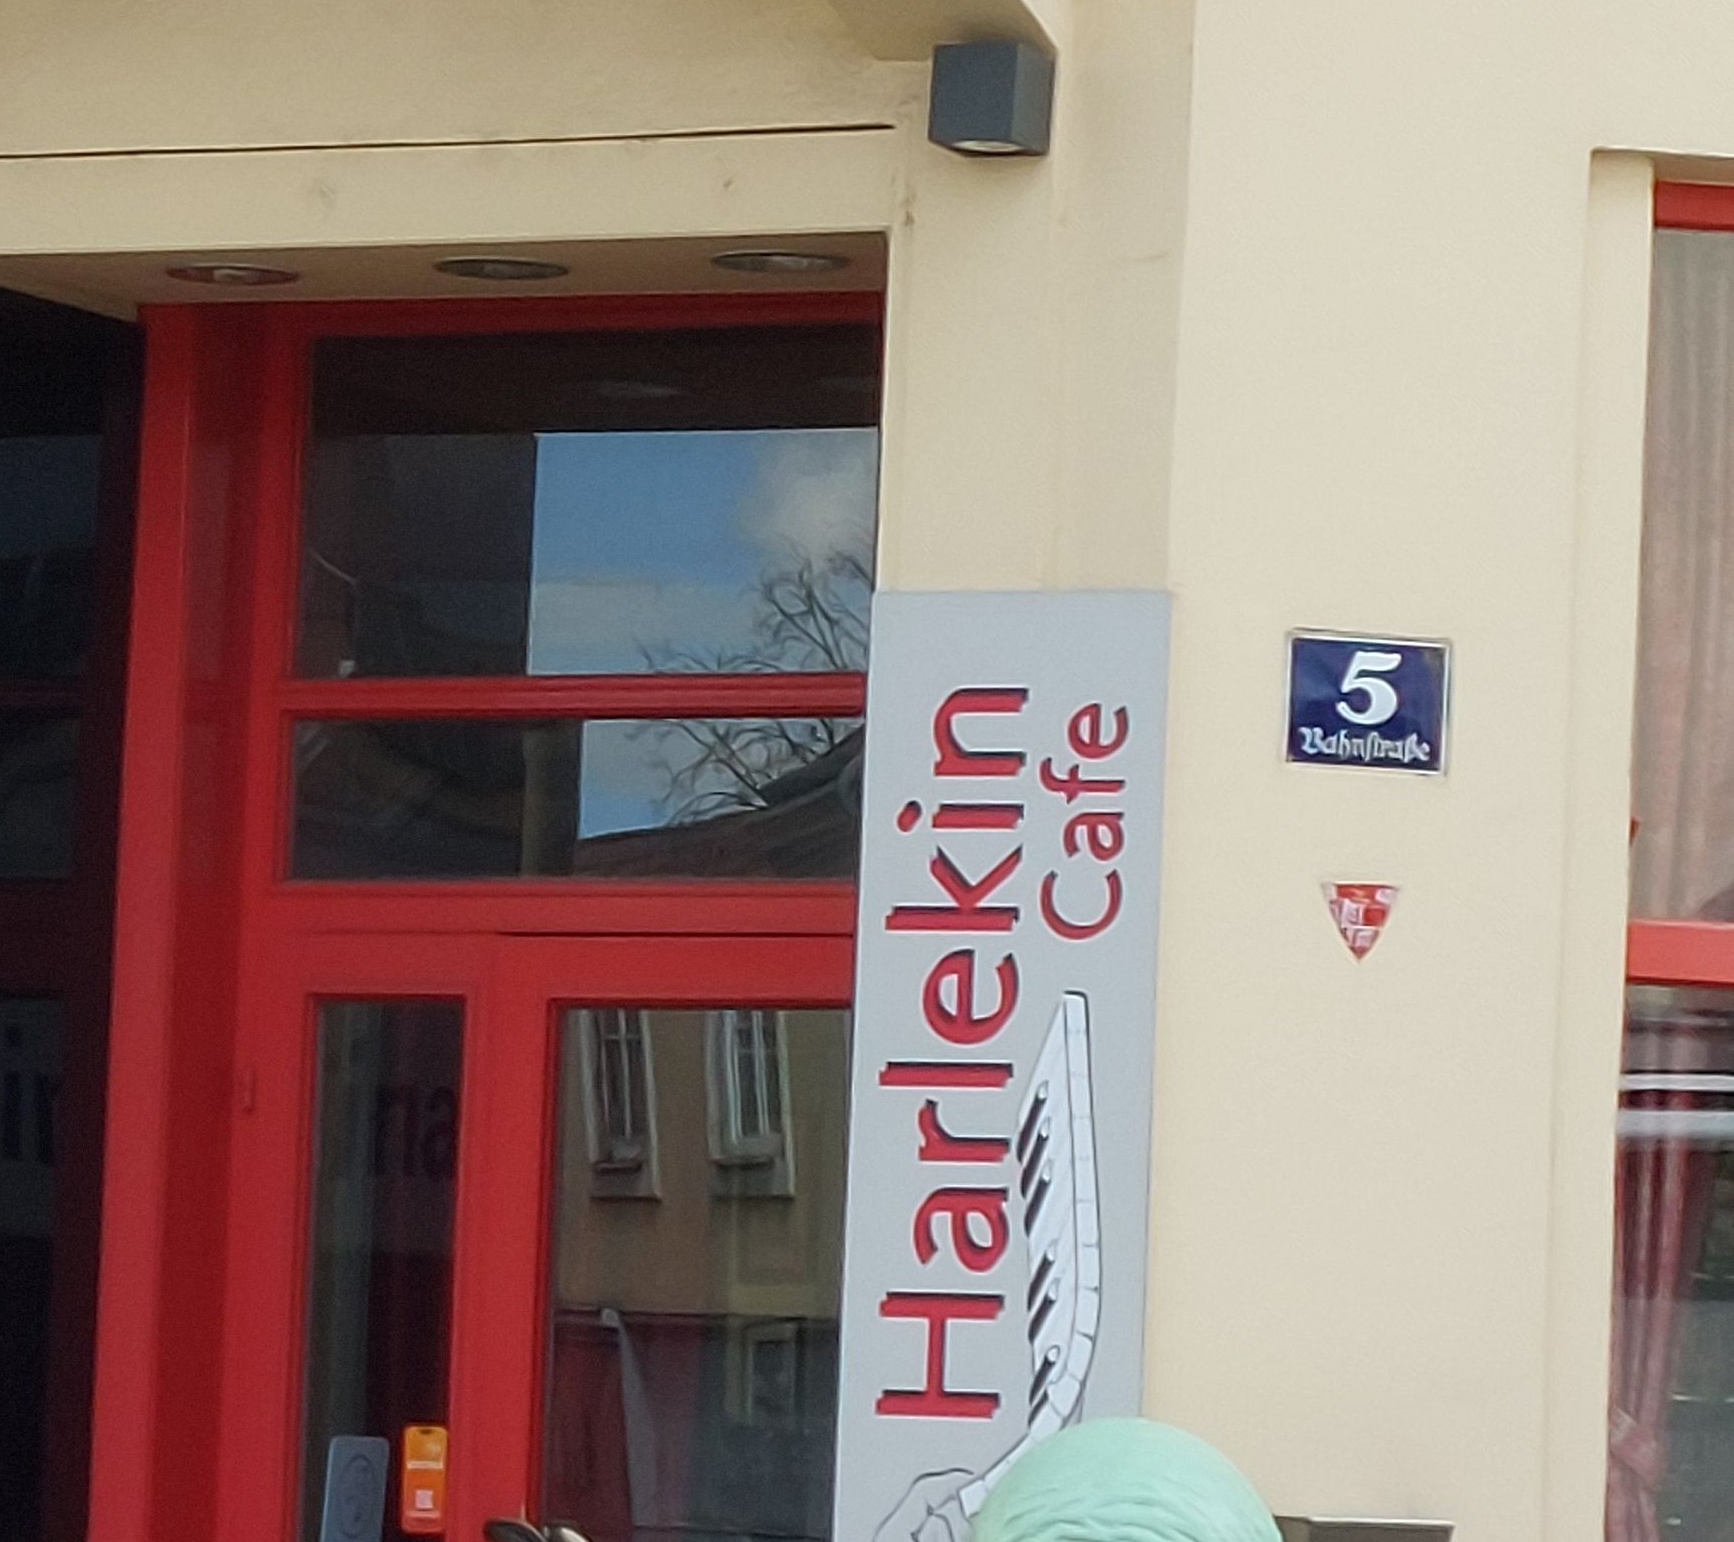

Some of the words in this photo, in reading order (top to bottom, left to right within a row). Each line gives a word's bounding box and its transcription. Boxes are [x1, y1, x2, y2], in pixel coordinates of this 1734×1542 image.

[1335, 650, 1402, 725] 5
[1040, 701, 1128, 939] Cafe
[876, 687, 1028, 1419] Harlekin
